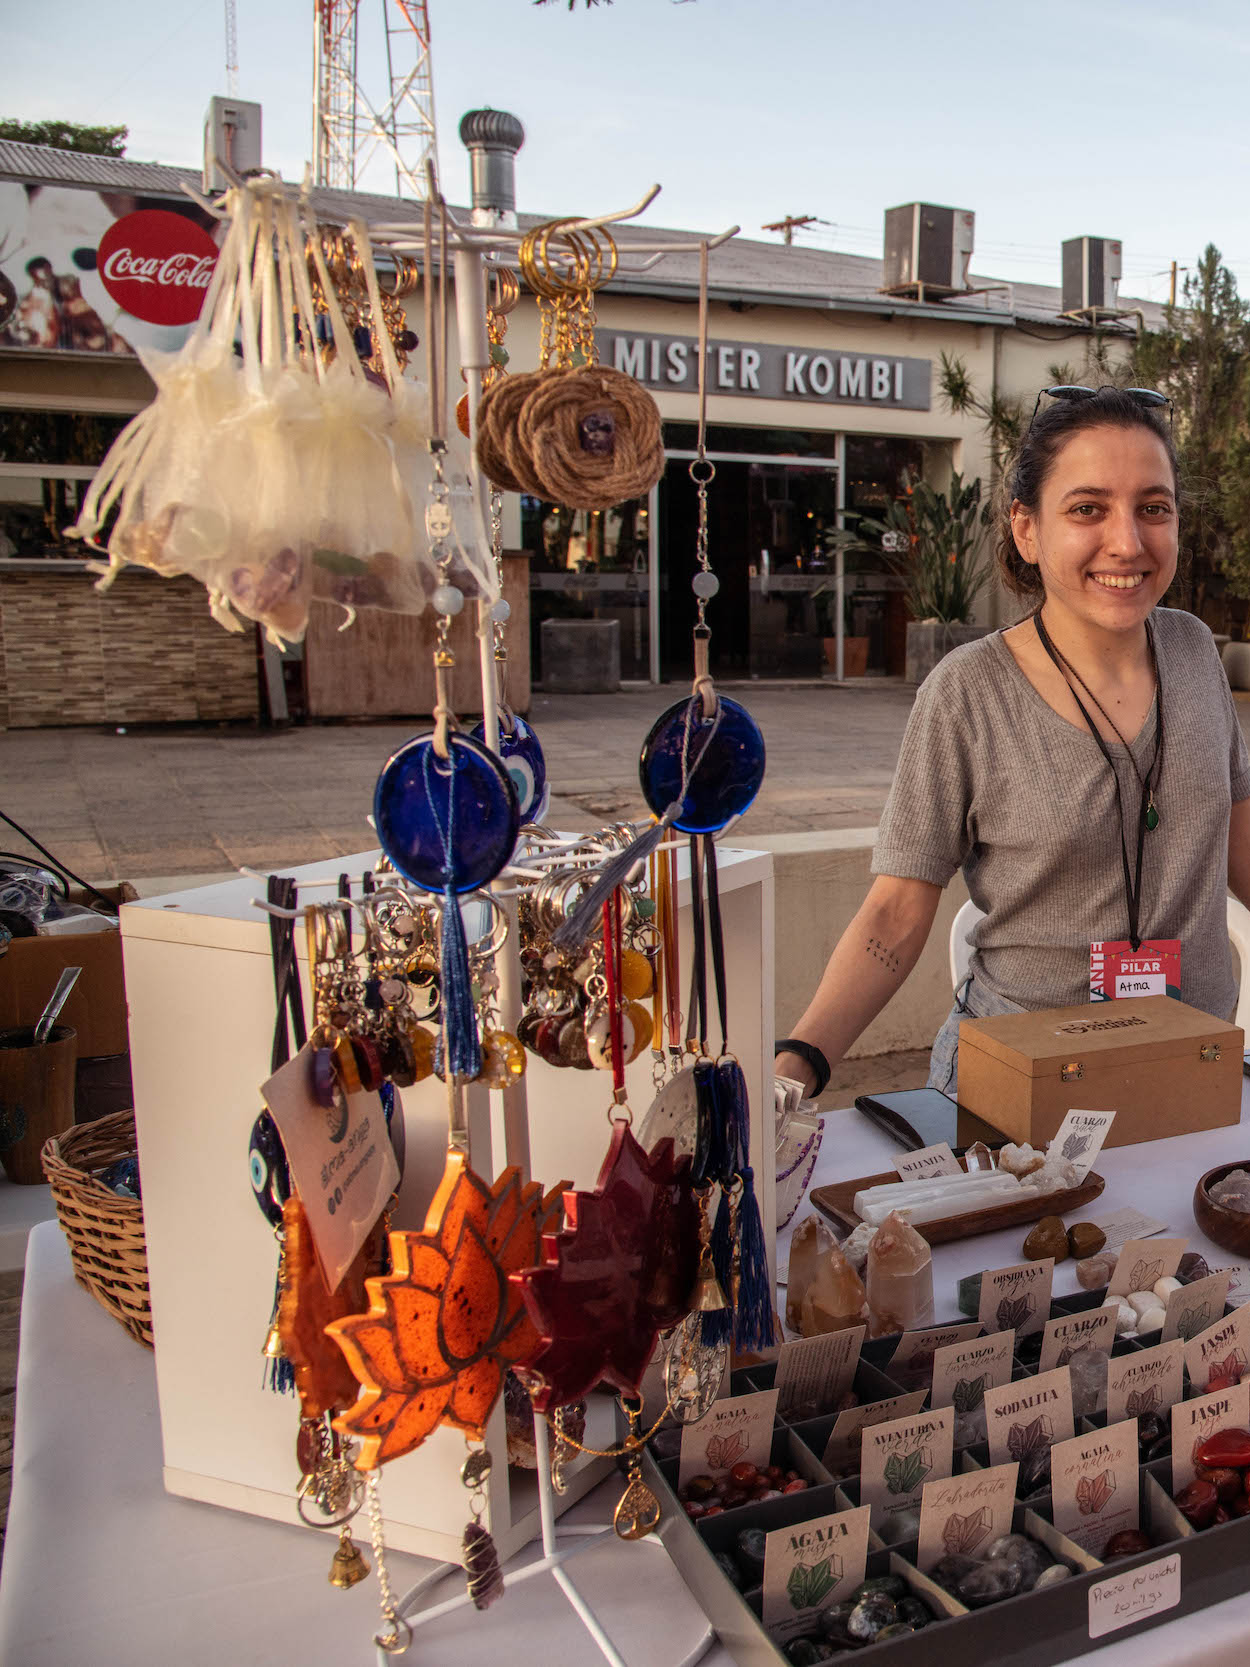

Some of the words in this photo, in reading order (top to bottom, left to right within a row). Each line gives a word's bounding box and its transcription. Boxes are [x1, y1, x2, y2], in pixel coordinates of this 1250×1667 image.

[786, 352, 903, 400] KOMBI
[1120, 962, 1161, 973] PILAR
[1120, 981, 1150, 992] Atma
[1070, 1116, 1107, 1126] CUARZO
[902, 1154, 946, 1173] SELENITA
[993, 1267, 1043, 1285] OBSIDIANA
[1054, 1315, 1108, 1339] CUARZO
[1200, 1323, 1239, 1356] JASPE
[956, 1347, 994, 1363] CUARZO
[1127, 1360, 1162, 1377] CUARZO
[995, 1389, 1058, 1419] SODALITA
[1191, 1399, 1234, 1425] JASPE
[874, 1420, 945, 1446] AVENTURINA
[881, 1432, 934, 1454] verde
